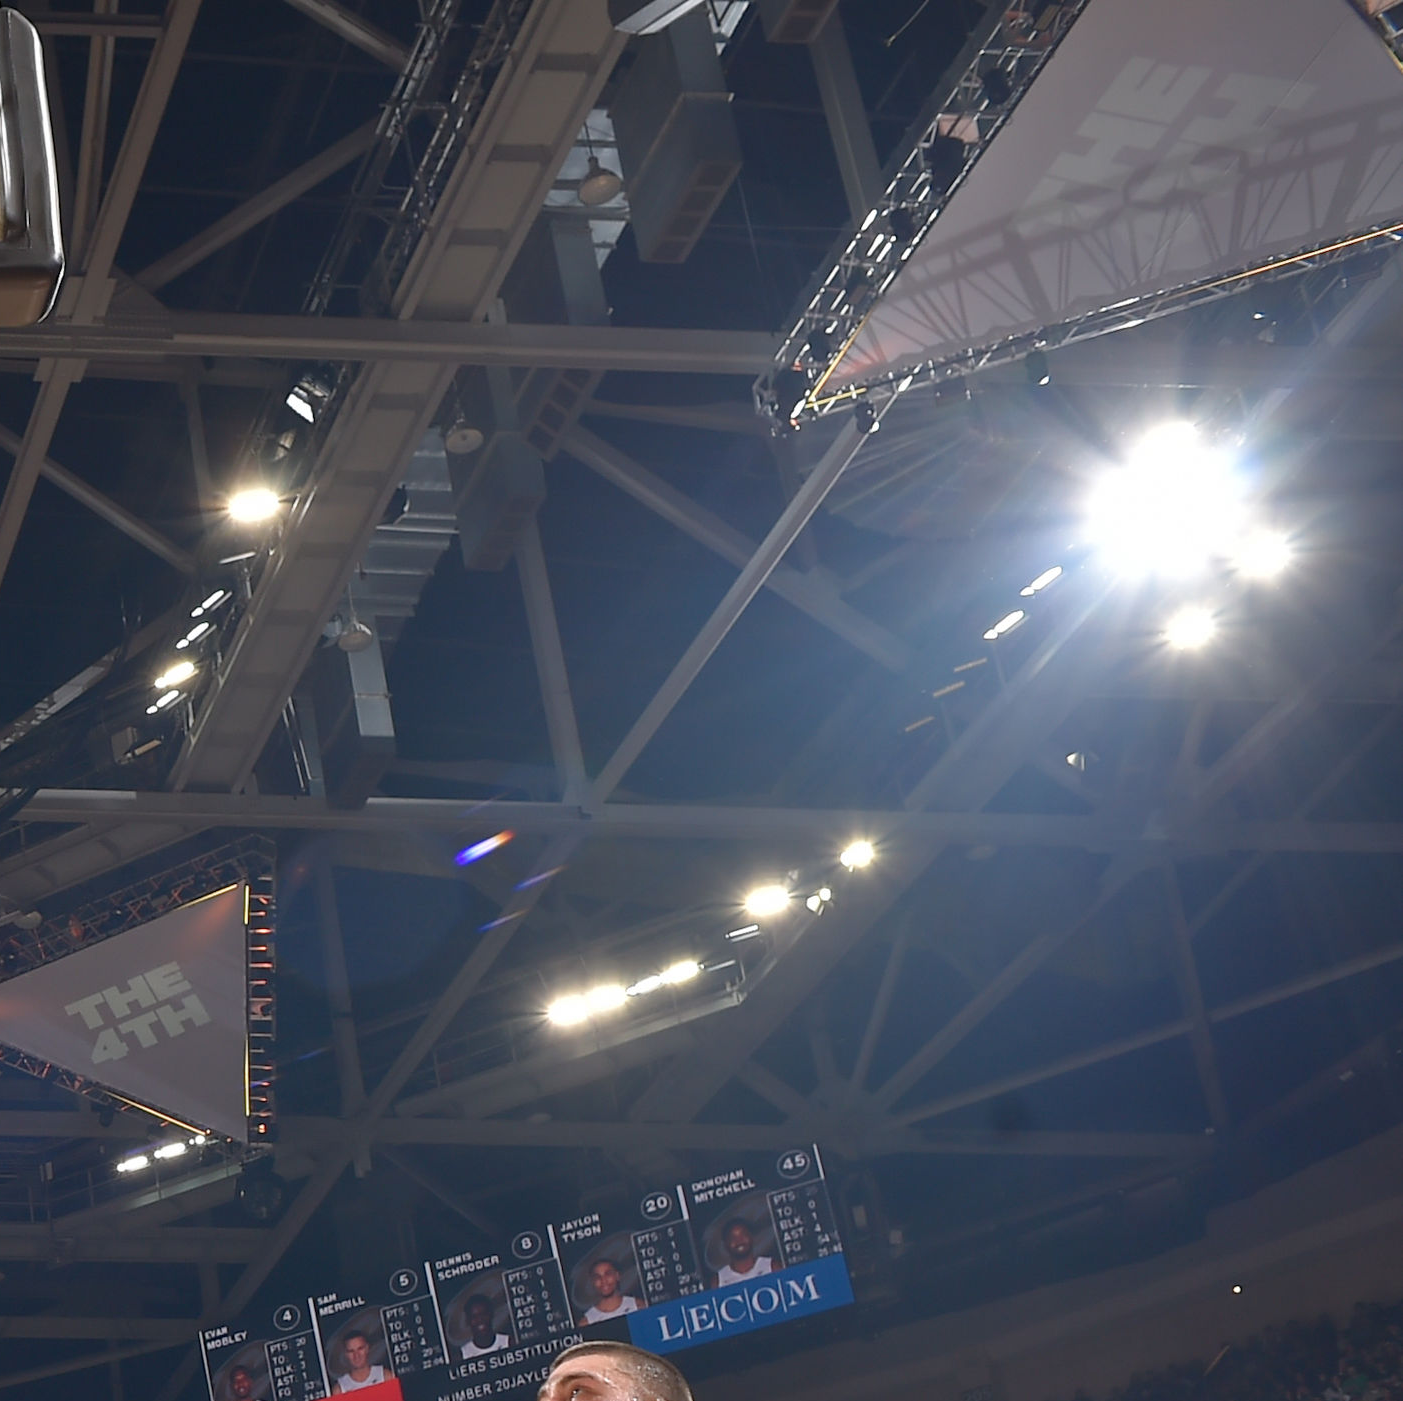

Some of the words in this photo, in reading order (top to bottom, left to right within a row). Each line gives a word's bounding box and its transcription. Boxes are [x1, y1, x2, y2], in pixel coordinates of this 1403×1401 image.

[63, 960, 193, 1031] THE
[89, 992, 211, 1065] 4TH
[782, 1154, 806, 1170] 45
[691, 1169, 744, 1192] DONOVAN
[694, 1178, 756, 1204] MITCHELL
[645, 1196, 668, 1212] 20
[521, 1237, 532, 1250] 8
[562, 1224, 602, 1244] TYSON
[437, 1255, 501, 1282] SCHRODER
[399, 1274, 409, 1287] 5
[281, 1310, 292, 1322] 4
[319, 1296, 366, 1317] MERRILL
[206, 1330, 248, 1351] MOBLEY
[448, 1360, 487, 1381] LIERS
